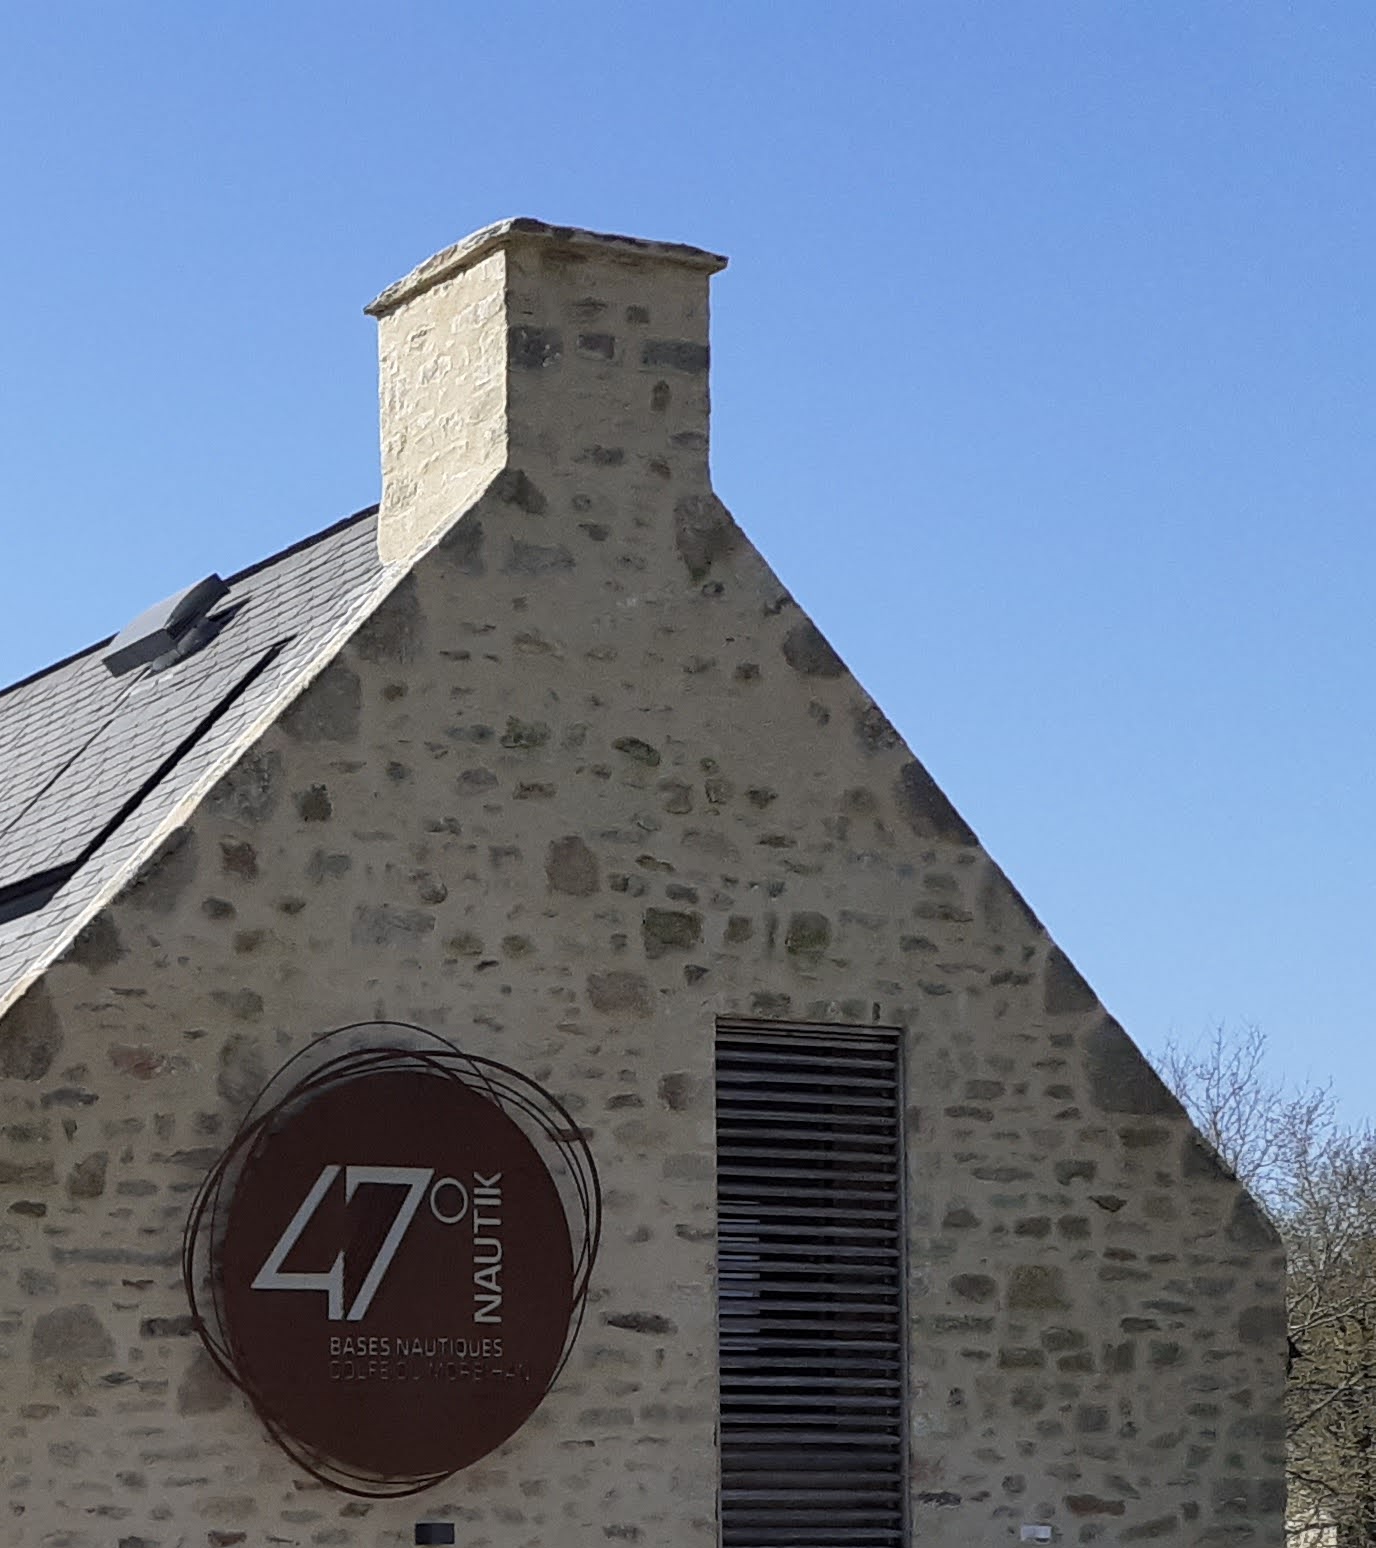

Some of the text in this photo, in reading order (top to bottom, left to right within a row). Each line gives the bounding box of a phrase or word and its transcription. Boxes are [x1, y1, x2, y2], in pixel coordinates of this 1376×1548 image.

[474, 1171, 503, 1323] NAUTIK
[330, 1337, 504, 1358] BASES NAUTIQUES
